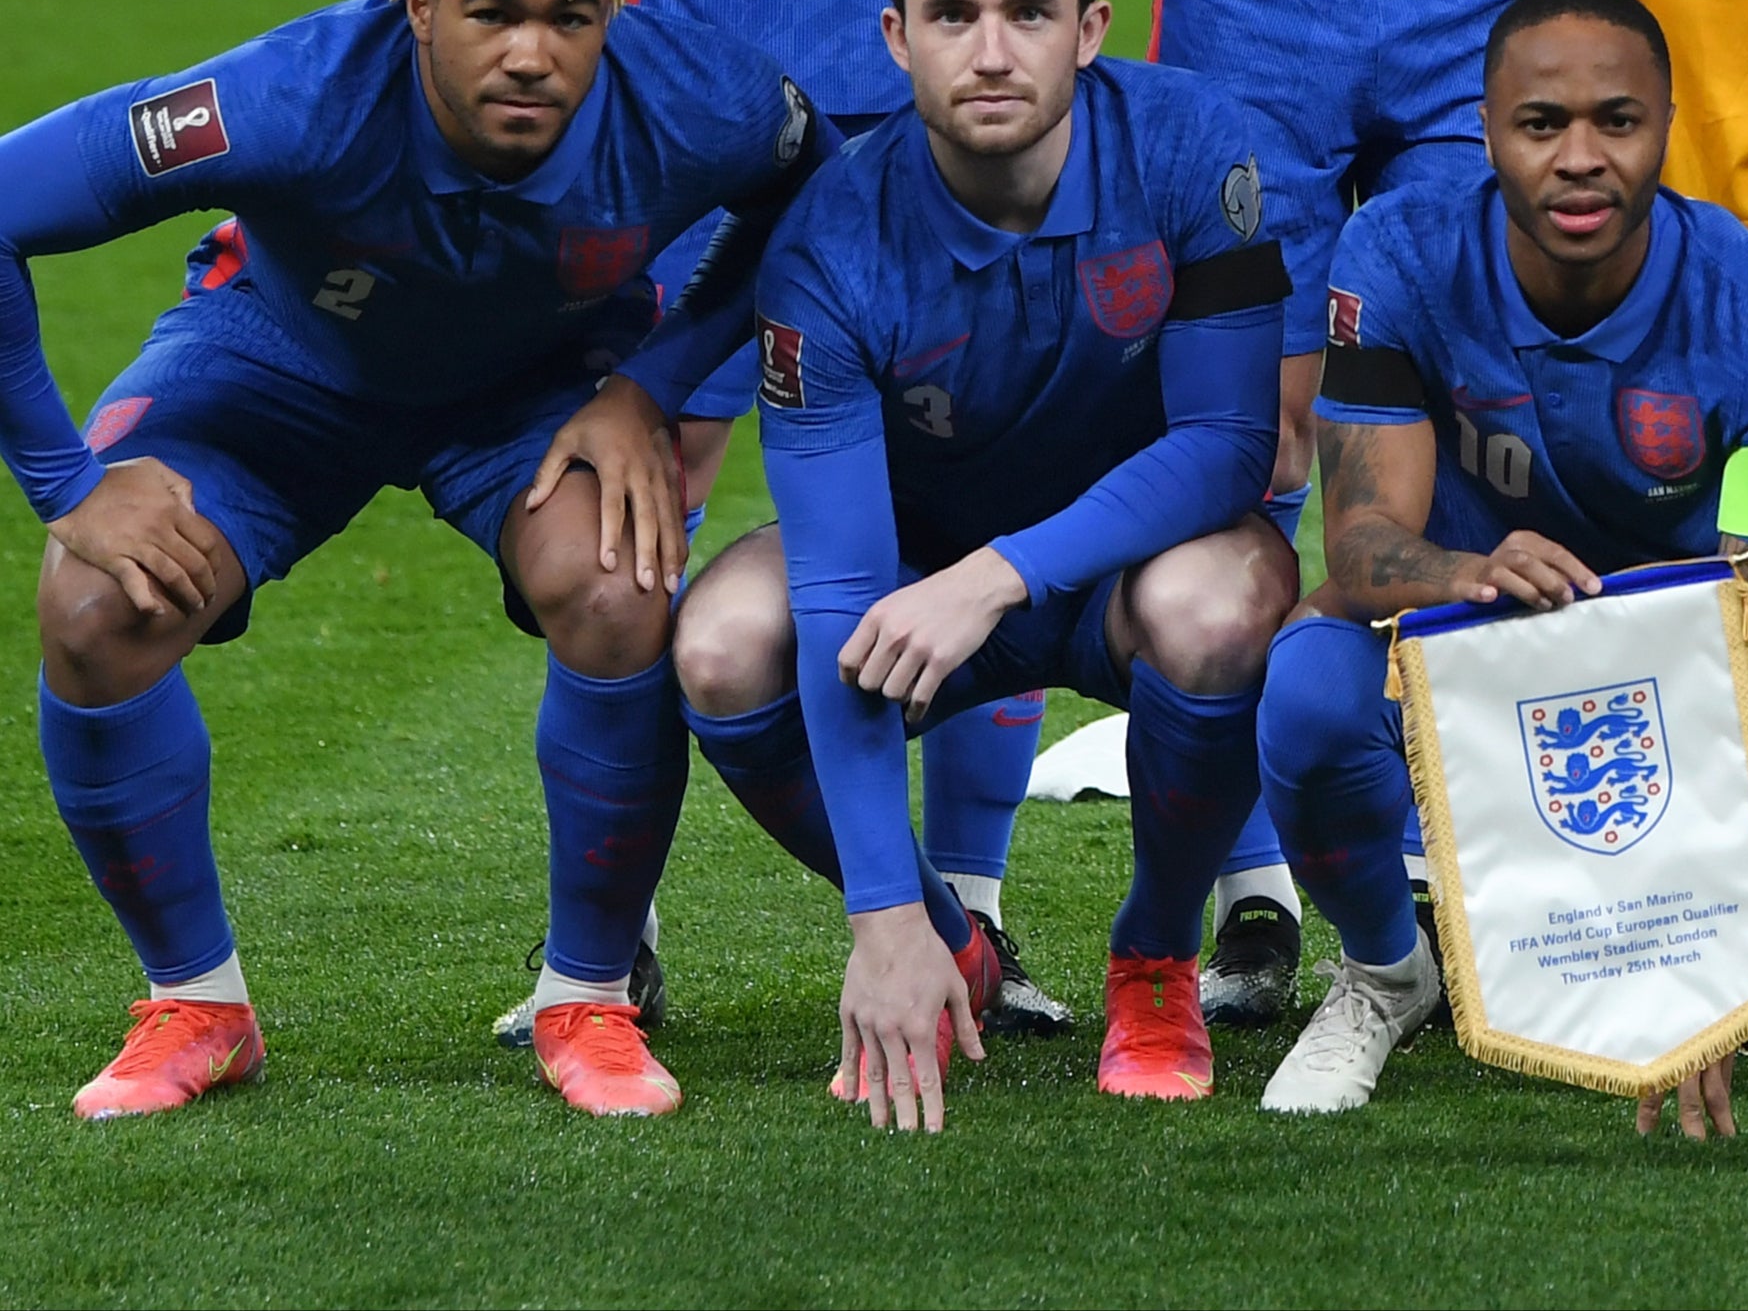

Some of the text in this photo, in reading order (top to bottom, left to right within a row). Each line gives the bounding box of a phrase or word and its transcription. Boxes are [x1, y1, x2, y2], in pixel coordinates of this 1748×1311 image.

[312, 269, 375, 321] 2
[903, 384, 953, 438] 3
[1455, 410, 1533, 499] 10
[1509, 902, 1740, 953] FIFA World Cup European Qualifier
[1548, 890, 1694, 926] England v San Marino
[1537, 927, 1718, 968] Wembley Stadium, London
[1561, 950, 1702, 985] Thursday 25th March
